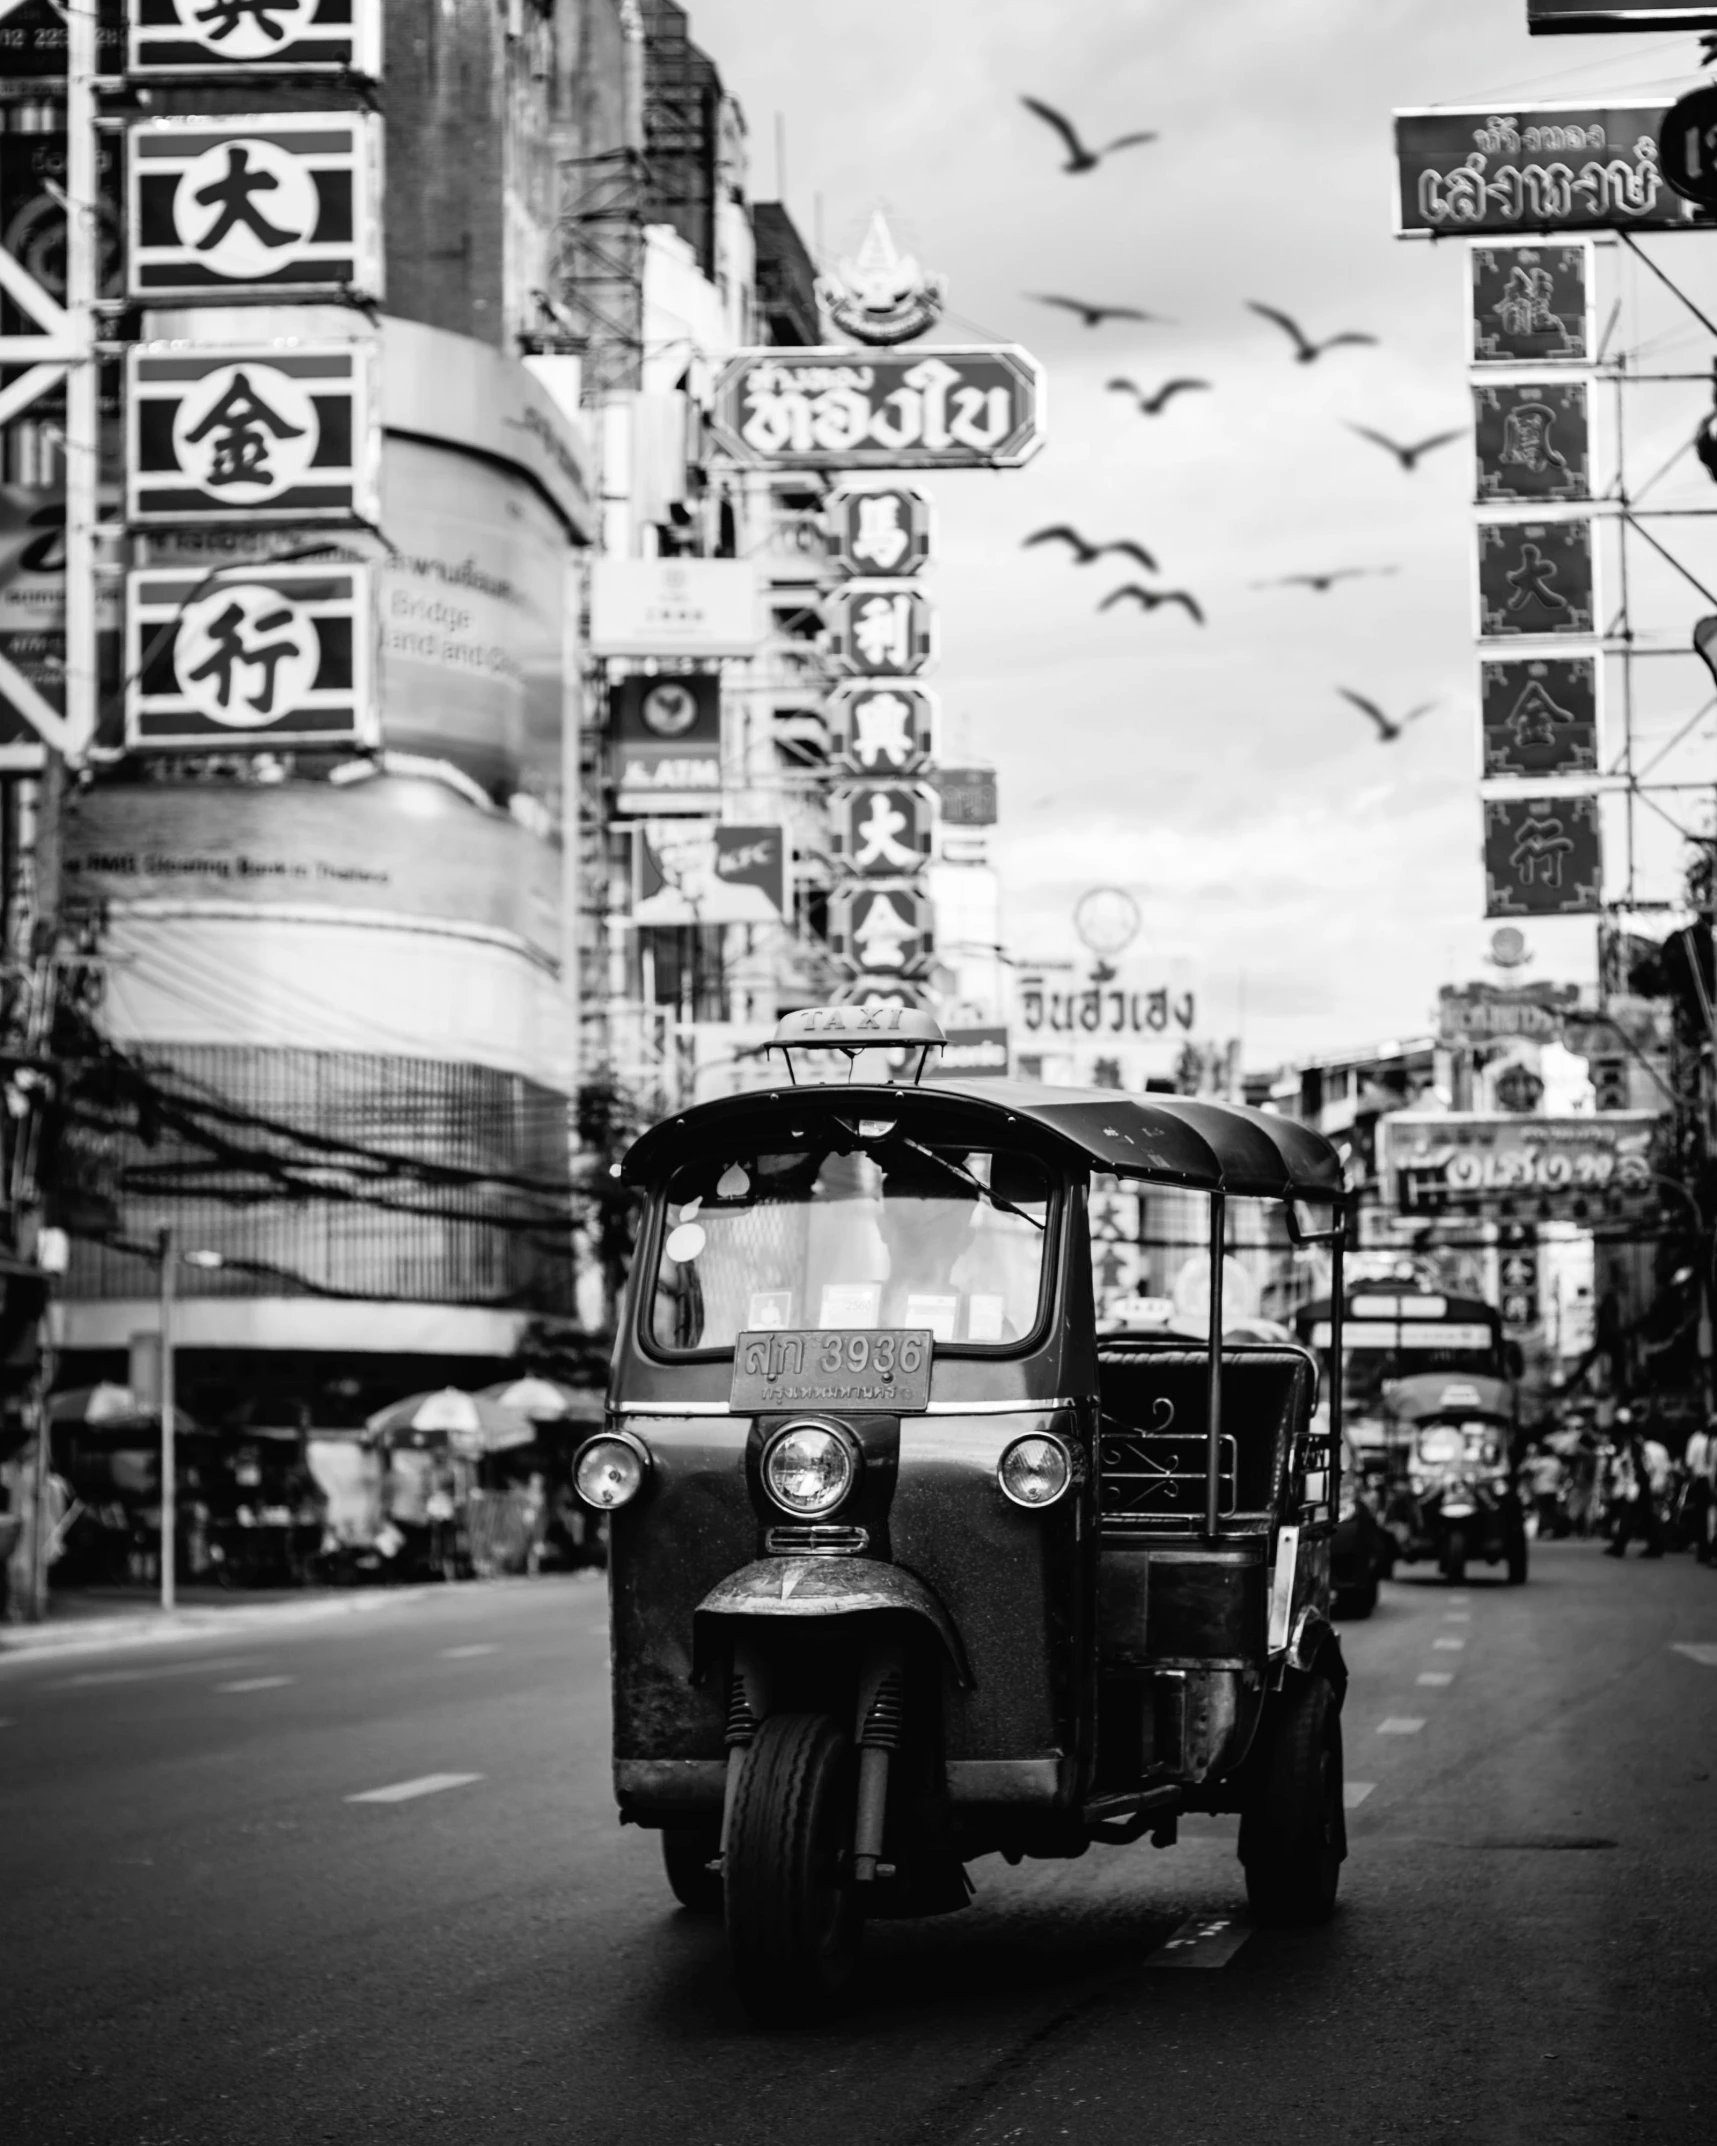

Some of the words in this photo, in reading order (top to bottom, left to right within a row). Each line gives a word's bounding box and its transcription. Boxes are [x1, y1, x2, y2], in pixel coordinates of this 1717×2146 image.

[853, 495, 921, 1067] 馬利興大金
[800, 1008, 903, 1031] TAXI
[820, 1334, 922, 1374] 3936
[761, 1385, 897, 1406] กรุงเทพมหานคร
